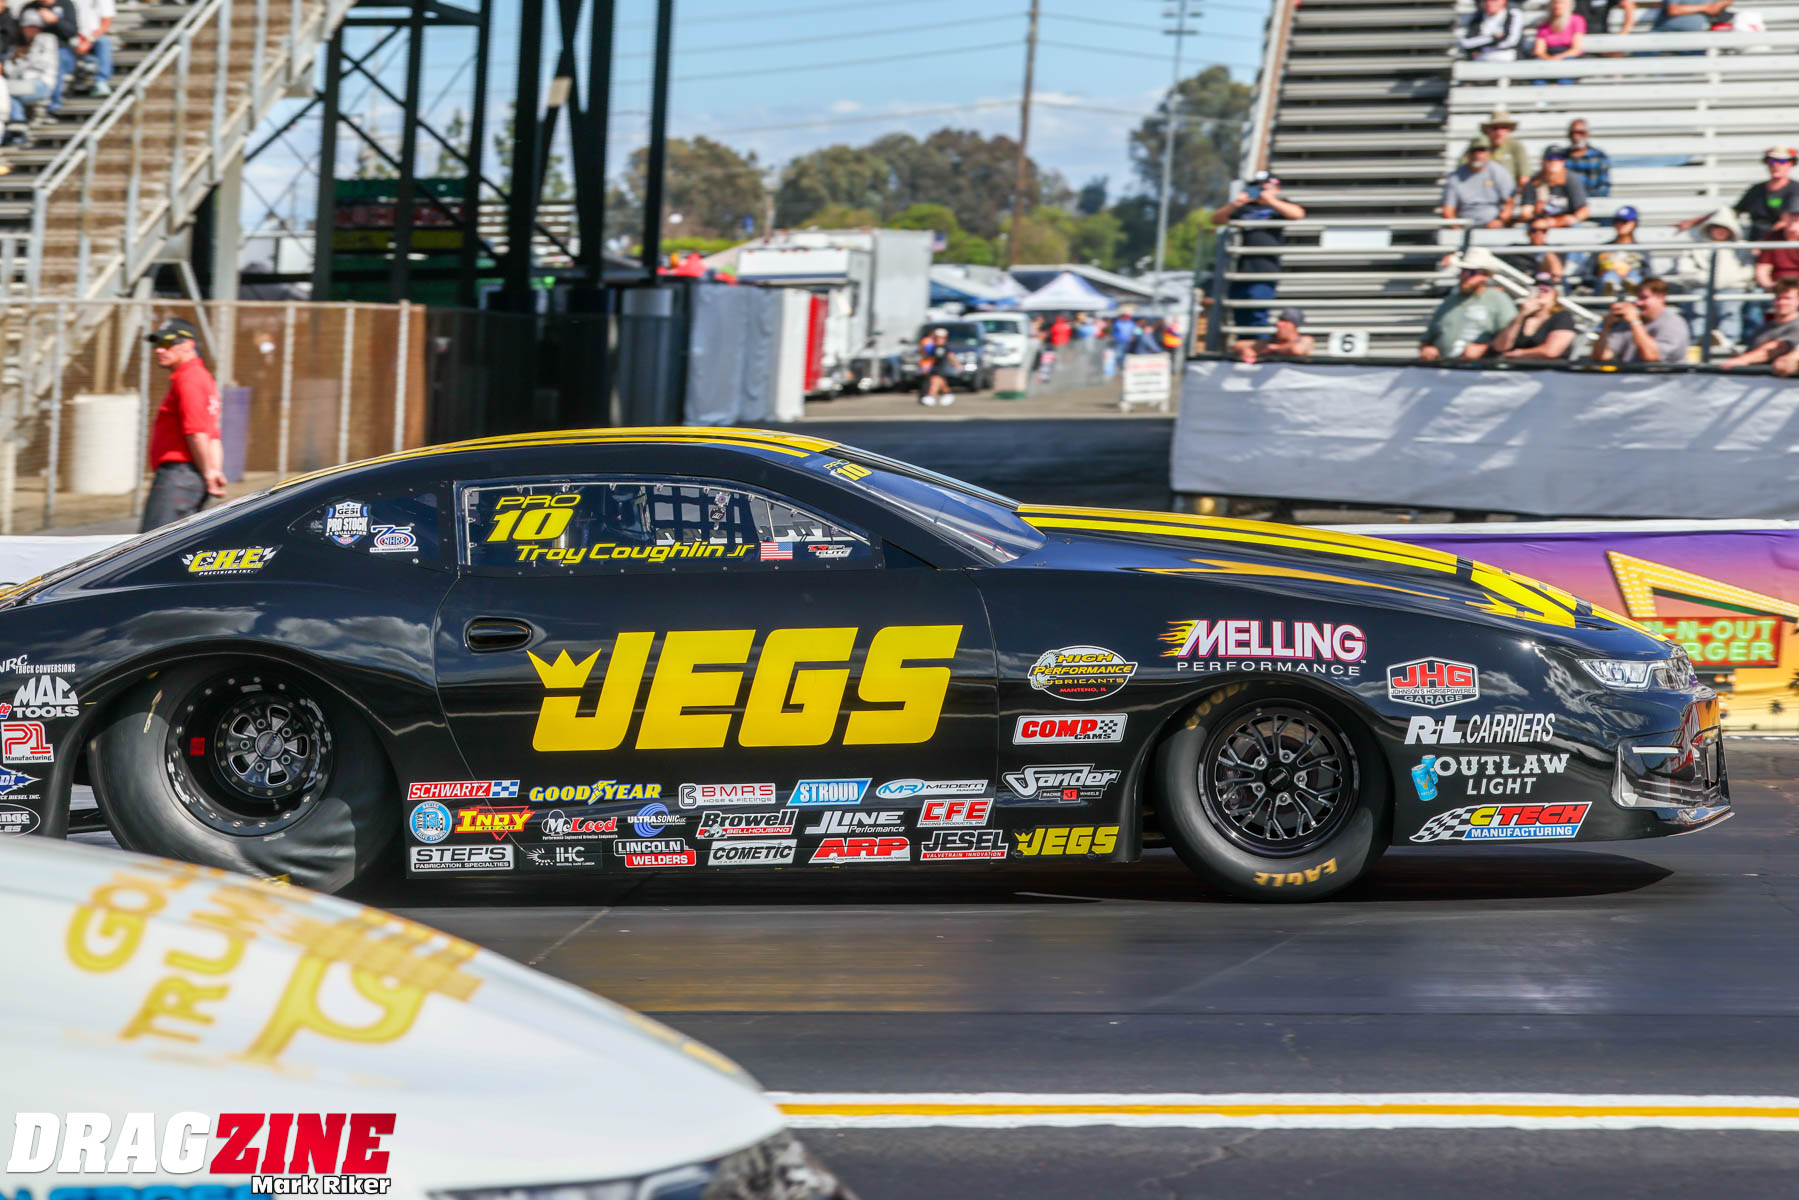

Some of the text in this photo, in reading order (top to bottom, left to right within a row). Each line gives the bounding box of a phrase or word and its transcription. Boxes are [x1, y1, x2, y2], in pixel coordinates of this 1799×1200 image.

[1341, 334, 1354, 353] 6
[837, 463, 873, 481] 10
[495, 495, 580, 509] PRO
[327, 518, 342, 533] PRO
[343, 516, 368, 531] STOCK
[486, 508, 575, 542] 10
[383, 536, 405, 545] NHRA
[188, 549, 264, 573] C.H.E.
[516, 545, 587, 564] Troy
[588, 542, 725, 562] Coughlin
[1643, 619, 1777, 640] N-N-OUT
[1177, 619, 1366, 662] MELLING
[1057, 653, 1115, 664] HIGH
[1681, 641, 1775, 661] RGER
[16, 663, 76, 674] TRUCK CONVERSIONS
[1033, 665, 1133, 676] PERFORMANCE
[1177, 661, 1361, 676] PERFORMANCE
[1392, 663, 1473, 688] JHG
[13, 674, 79, 706] MAC
[528, 625, 964, 752] JEGS
[1037, 677, 1125, 686] LUBRICANTS
[1404, 695, 1463, 705] GARAGE
[13, 705, 80, 718] TOOLS
[1021, 719, 1098, 739] COMP
[1466, 713, 1556, 743] CARRIERS
[4, 723, 51, 755] P1
[1434, 753, 1570, 776] OUTLAW
[882, 784, 919, 794] MR
[1006, 766, 1118, 796] Sander
[1467, 777, 1537, 794] LIGHT
[410, 784, 491, 799] SCHWARTZ
[702, 785, 774, 797] BMRS
[800, 782, 859, 803] STROUD
[628, 815, 679, 823] ULTRASONIC
[700, 810, 797, 828] Browell
[923, 801, 989, 820] CFE
[1469, 804, 1588, 825] CTECH
[457, 810, 531, 832] INDY
[546, 816, 618, 834] McLeod
[922, 831, 1007, 851] JESEL
[1014, 826, 1120, 856] JEGS
[1471, 826, 1573, 838] MANUFACTURING
[415, 847, 507, 862] STEF'S
[555, 846, 585, 862] IHC
[617, 841, 681, 853] LINCOLN
[712, 845, 793, 860] COMETIC
[814, 838, 909, 858] ARP
[632, 854, 688, 865] WELDERS
[1253, 858, 1338, 887] EAGLE
